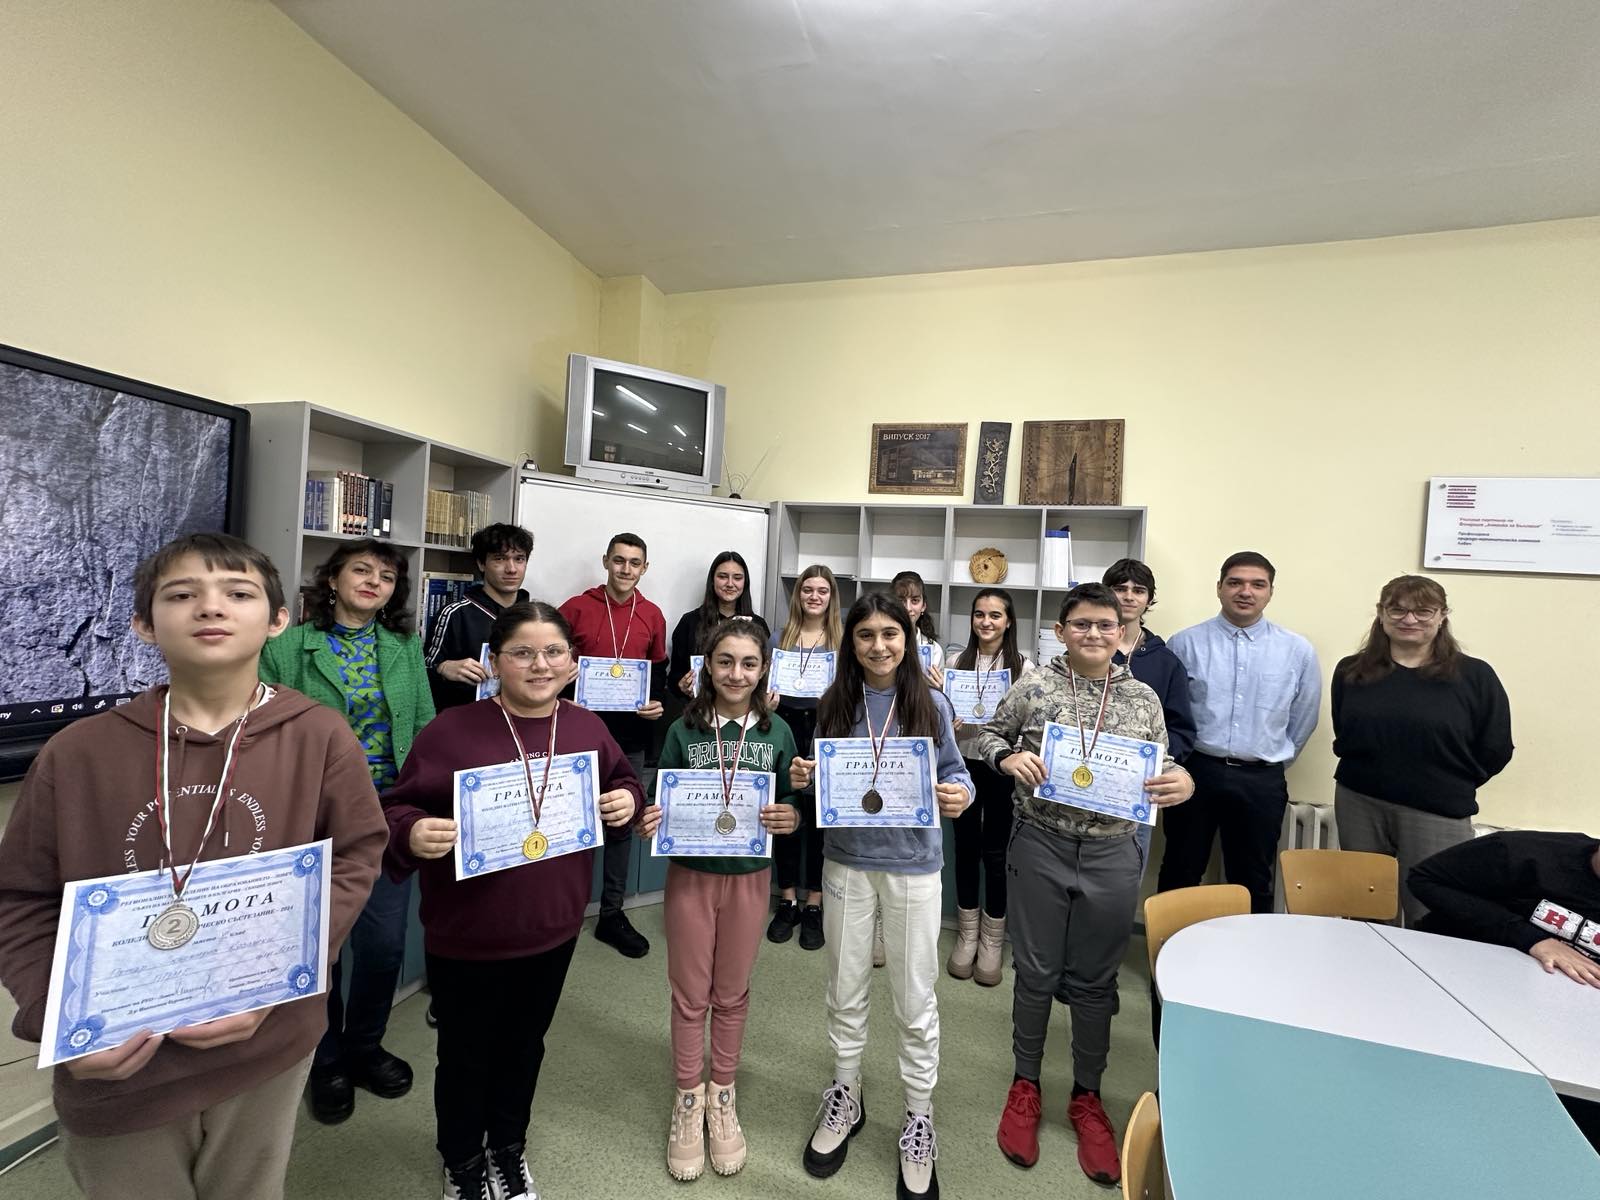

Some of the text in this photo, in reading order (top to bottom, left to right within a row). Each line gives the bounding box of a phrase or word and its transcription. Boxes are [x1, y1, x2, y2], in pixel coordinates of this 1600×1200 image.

[0, 712, 11, 720] ny
[126, 811, 149, 842] YOUR
[237, 792, 267, 832] ENDLESS
[141, 891, 274, 929] ГМОТА
[166, 918, 182, 935] 2
[111, 935, 149, 948] КОЛЕДН
